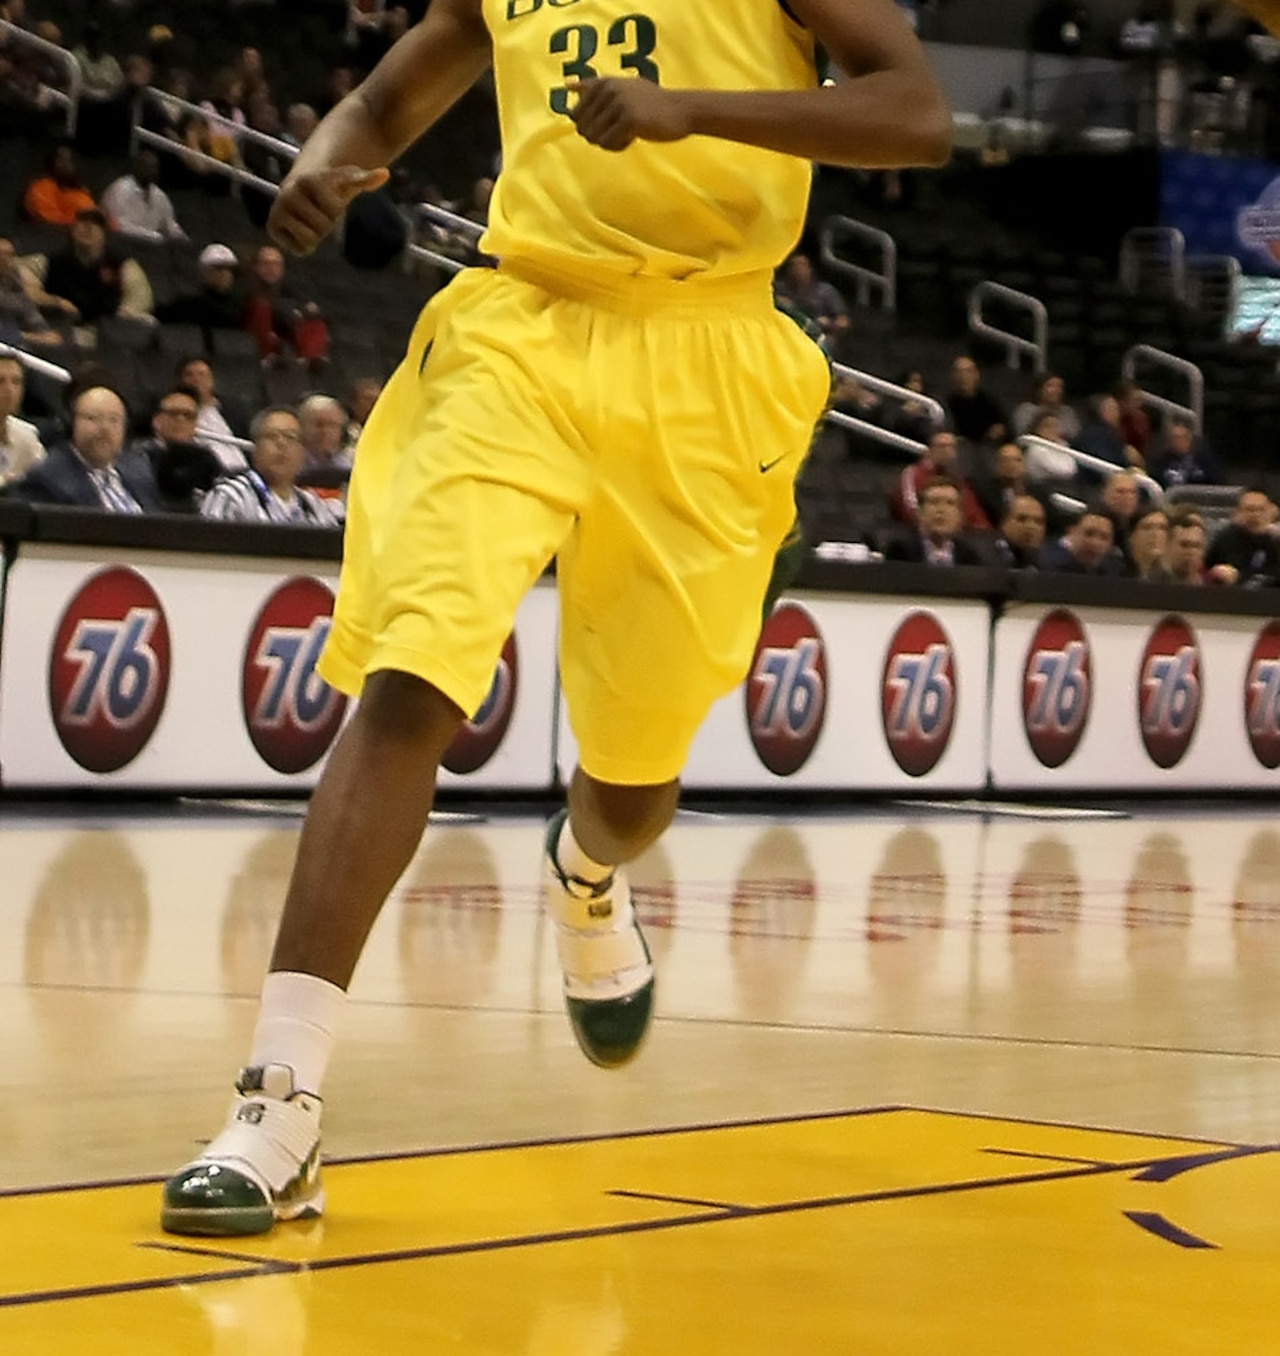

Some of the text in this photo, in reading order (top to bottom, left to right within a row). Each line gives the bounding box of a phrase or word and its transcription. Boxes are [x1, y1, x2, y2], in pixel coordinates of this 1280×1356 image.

[548, 12, 660, 117] 33
[65, 607, 158, 729] 76
[254, 614, 336, 730] 76
[749, 637, 822, 737] 76
[884, 643, 953, 738] 76
[1029, 640, 1088, 733] 76
[1142, 645, 1201, 735] 76
